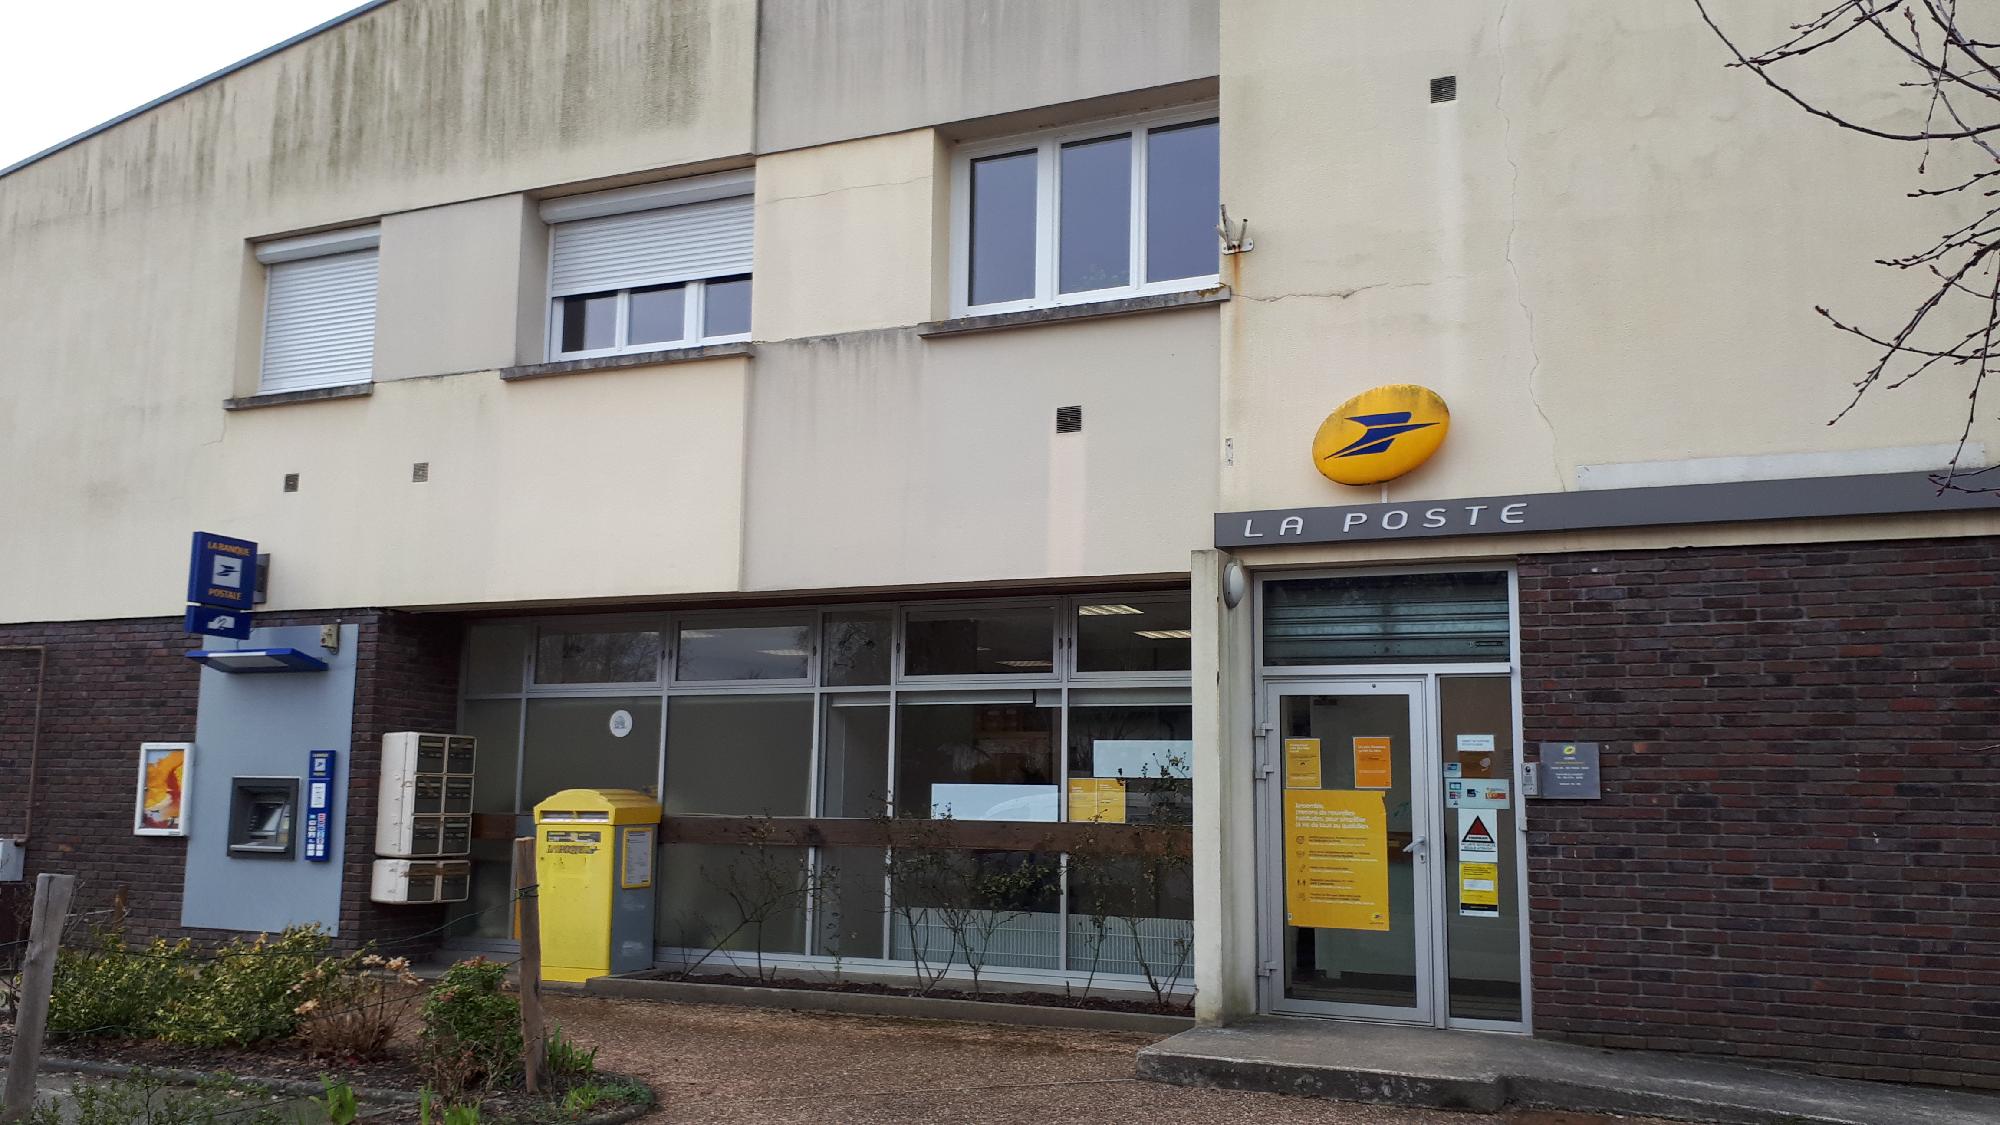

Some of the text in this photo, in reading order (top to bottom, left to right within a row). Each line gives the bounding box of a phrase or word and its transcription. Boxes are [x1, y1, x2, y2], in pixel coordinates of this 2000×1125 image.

[1244, 503, 1528, 537] LA POSTE
[208, 588, 241, 600] POSTALE
